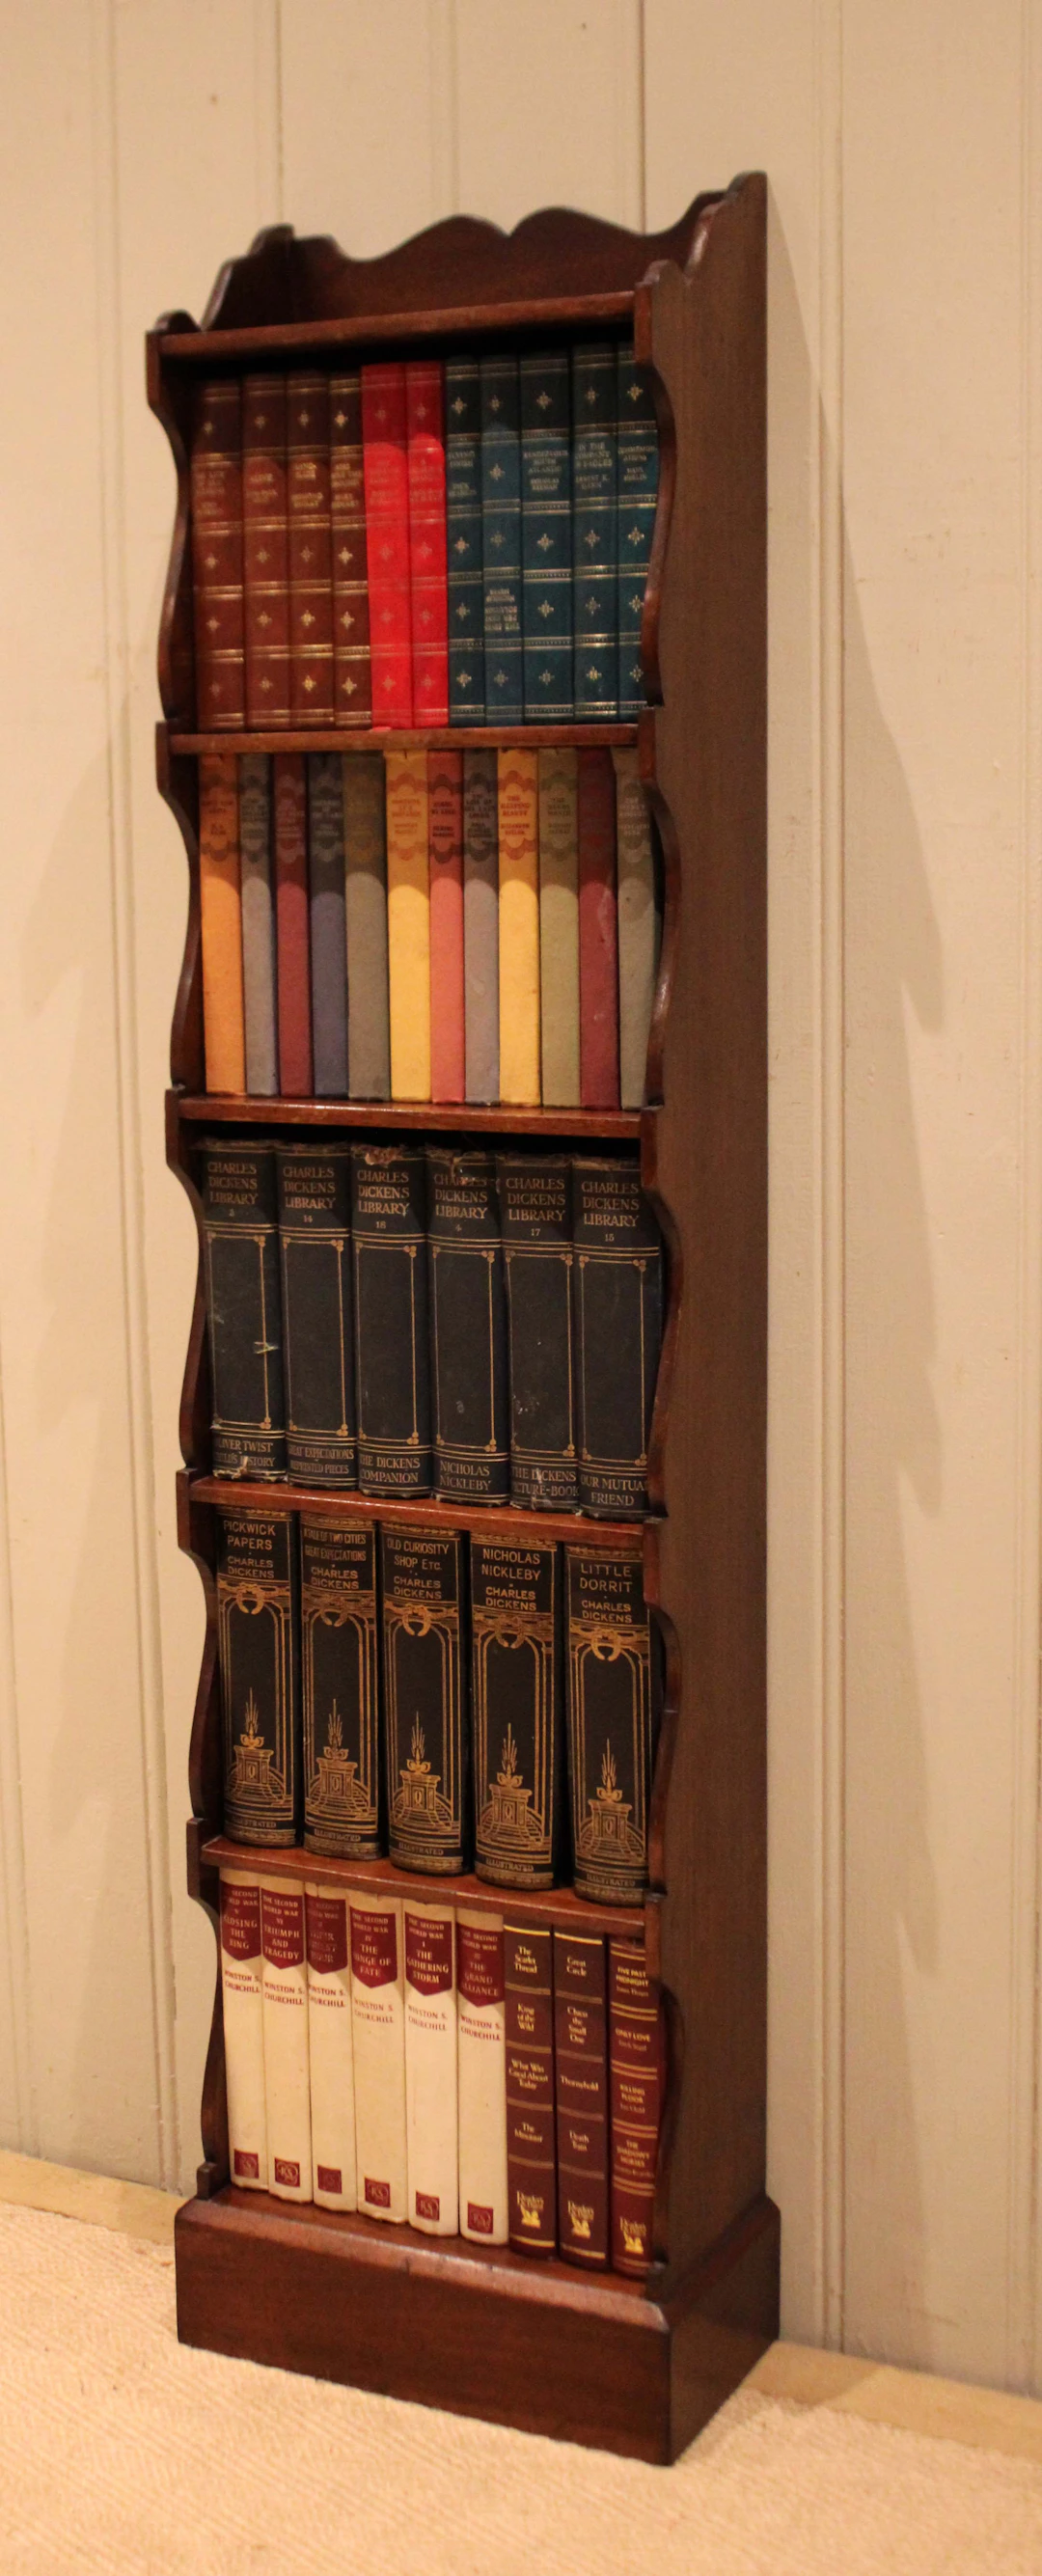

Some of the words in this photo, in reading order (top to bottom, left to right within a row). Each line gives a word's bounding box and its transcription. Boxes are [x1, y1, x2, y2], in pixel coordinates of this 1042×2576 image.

[207, 1162, 257, 1175] CHARLES
[283, 1166, 335, 1179] CHARLES
[357, 1169, 409, 1183] CHARLES
[208, 1177, 258, 1190] DICKENS
[284, 1181, 336, 1193] DICKENS
[506, 1177, 564, 1190] CHARLES
[581, 1181, 639, 1194] CHARLES
[209, 1192, 259, 1205] LIBRARY
[358, 1185, 409, 1199] DICKENS
[435, 1189, 487, 1203] DICKENS
[285, 1196, 336, 1210] LIBRARY
[507, 1192, 565, 1206] DICKENS
[583, 1196, 640, 1211] DICKENS
[358, 1200, 410, 1217] LIBRARY
[435, 1204, 487, 1219] LIBRARY
[508, 1208, 565, 1221] LIBRARY
[584, 1213, 640, 1227] LIBRARY
[531, 1228, 540, 1237] 17
[243, 1440, 273, 1453] TWIST
[305, 1447, 354, 1459] EXPECTATIONS
[240, 1456, 276, 1467] HSTORY
[360, 1454, 373, 1466] THE
[377, 1456, 421, 1469] DICKENS
[440, 1460, 490, 1476] NICHOLAS
[325, 1464, 348, 1474] PIECES
[361, 1468, 419, 1483] COMPANION
[512, 1466, 529, 1480] THE
[440, 1475, 491, 1491] NICKLEBY
[581, 1475, 599, 1489] OUR
[591, 1493, 634, 1506] FRIEND
[224, 1520, 276, 1536] PICKWICK
[227, 1535, 273, 1550] PAPERS
[329, 1532, 343, 1543] TWO
[344, 1534, 366, 1544] CITIES
[387, 1538, 400, 1550] OLD
[403, 1541, 449, 1554] CURIOSITY
[321, 1548, 366, 1561] EXPECTATIONS
[482, 1548, 540, 1565] NICHOLAS
[228, 1555, 273, 1568] CHARLES
[394, 1555, 418, 1568] SHOP
[228, 1566, 274, 1578] DICKENS
[311, 1567, 358, 1578] CHARLES
[481, 1564, 541, 1580] NICKLEBY
[581, 1563, 632, 1577] LITTLE
[311, 1577, 359, 1590] DICKENS
[394, 1576, 441, 1588] CHARLES
[580, 1577, 632, 1593] DORRIT
[394, 1587, 442, 1600] DICKENS
[485, 1587, 535, 1601] CHARLES
[485, 1598, 536, 1611] DICKENS
[582, 1600, 631, 1612] CHARLES
[583, 1610, 632, 1624] DICKENS
[314, 1828, 361, 1842] ILLUSTRATED
[398, 1842, 444, 1856] ILLUSTRATED
[485, 1857, 534, 1872] ILLUSTRATED
[587, 1873, 636, 1886] ILLUSTRATED
[263, 1905, 282, 1915] WORLD
[274, 1900, 299, 1908] SECOND
[224, 1914, 258, 1928] CLOSING
[364, 1916, 389, 1925] SECOND
[420, 1921, 444, 1931] SECOND
[231, 1928, 245, 1938] THE
[264, 1924, 299, 1938] TRIUMPH
[409, 1928, 427, 1938] WORLD
[473, 1933, 498, 1942] SECOND
[272, 1938, 288, 1948] AND
[361, 1943, 377, 1955] THE
[264, 1945, 299, 1959] TRAGEDY
[416, 1949, 432, 1960] THE
[518, 1945, 532, 1956] The
[379, 1958, 391, 1966] OF
[407, 1957, 449, 1974] GATHERING
[515, 1953, 535, 1965] Scarlet
[566, 1956, 587, 1967] Great
[360, 1965, 379, 1977] FATE
[470, 1961, 485, 1971] THE
[514, 1961, 537, 1974] Thread
[566, 1964, 587, 1977] Circle
[225, 1970, 252, 1982] WINSTON
[413, 1970, 440, 1984] STORM
[465, 1972, 493, 1984] GRAND
[630, 1969, 646, 1978] PAST
[226, 1980, 260, 1993] CHURCHILL
[616, 1974, 649, 1987] MIDNIGHT
[265, 1981, 295, 1994] WINSTON
[462, 1981, 499, 1996] ALLIANCE
[265, 1992, 304, 2006] CHURCHILL
[354, 1997, 384, 2011] WINSTON
[408, 2004, 438, 2019] WINSTON
[517, 2003, 535, 2014] King
[354, 2009, 394, 2023] CHURCHILL
[460, 2014, 492, 2029] WINSTON
[525, 2013, 535, 2022] the
[572, 2015, 583, 2025] the
[408, 2016, 447, 2031] CHURCHILL
[518, 2020, 535, 2032] Wild
[460, 2026, 501, 2041] CHURCHILL
[568, 2024, 587, 2037] Small
[615, 2027, 631, 2039] ONLY
[633, 2032, 650, 2042] LOVE
[511, 2058, 529, 2069] What
[528, 2071, 548, 2082] About
[522, 2123, 535, 2133] The
